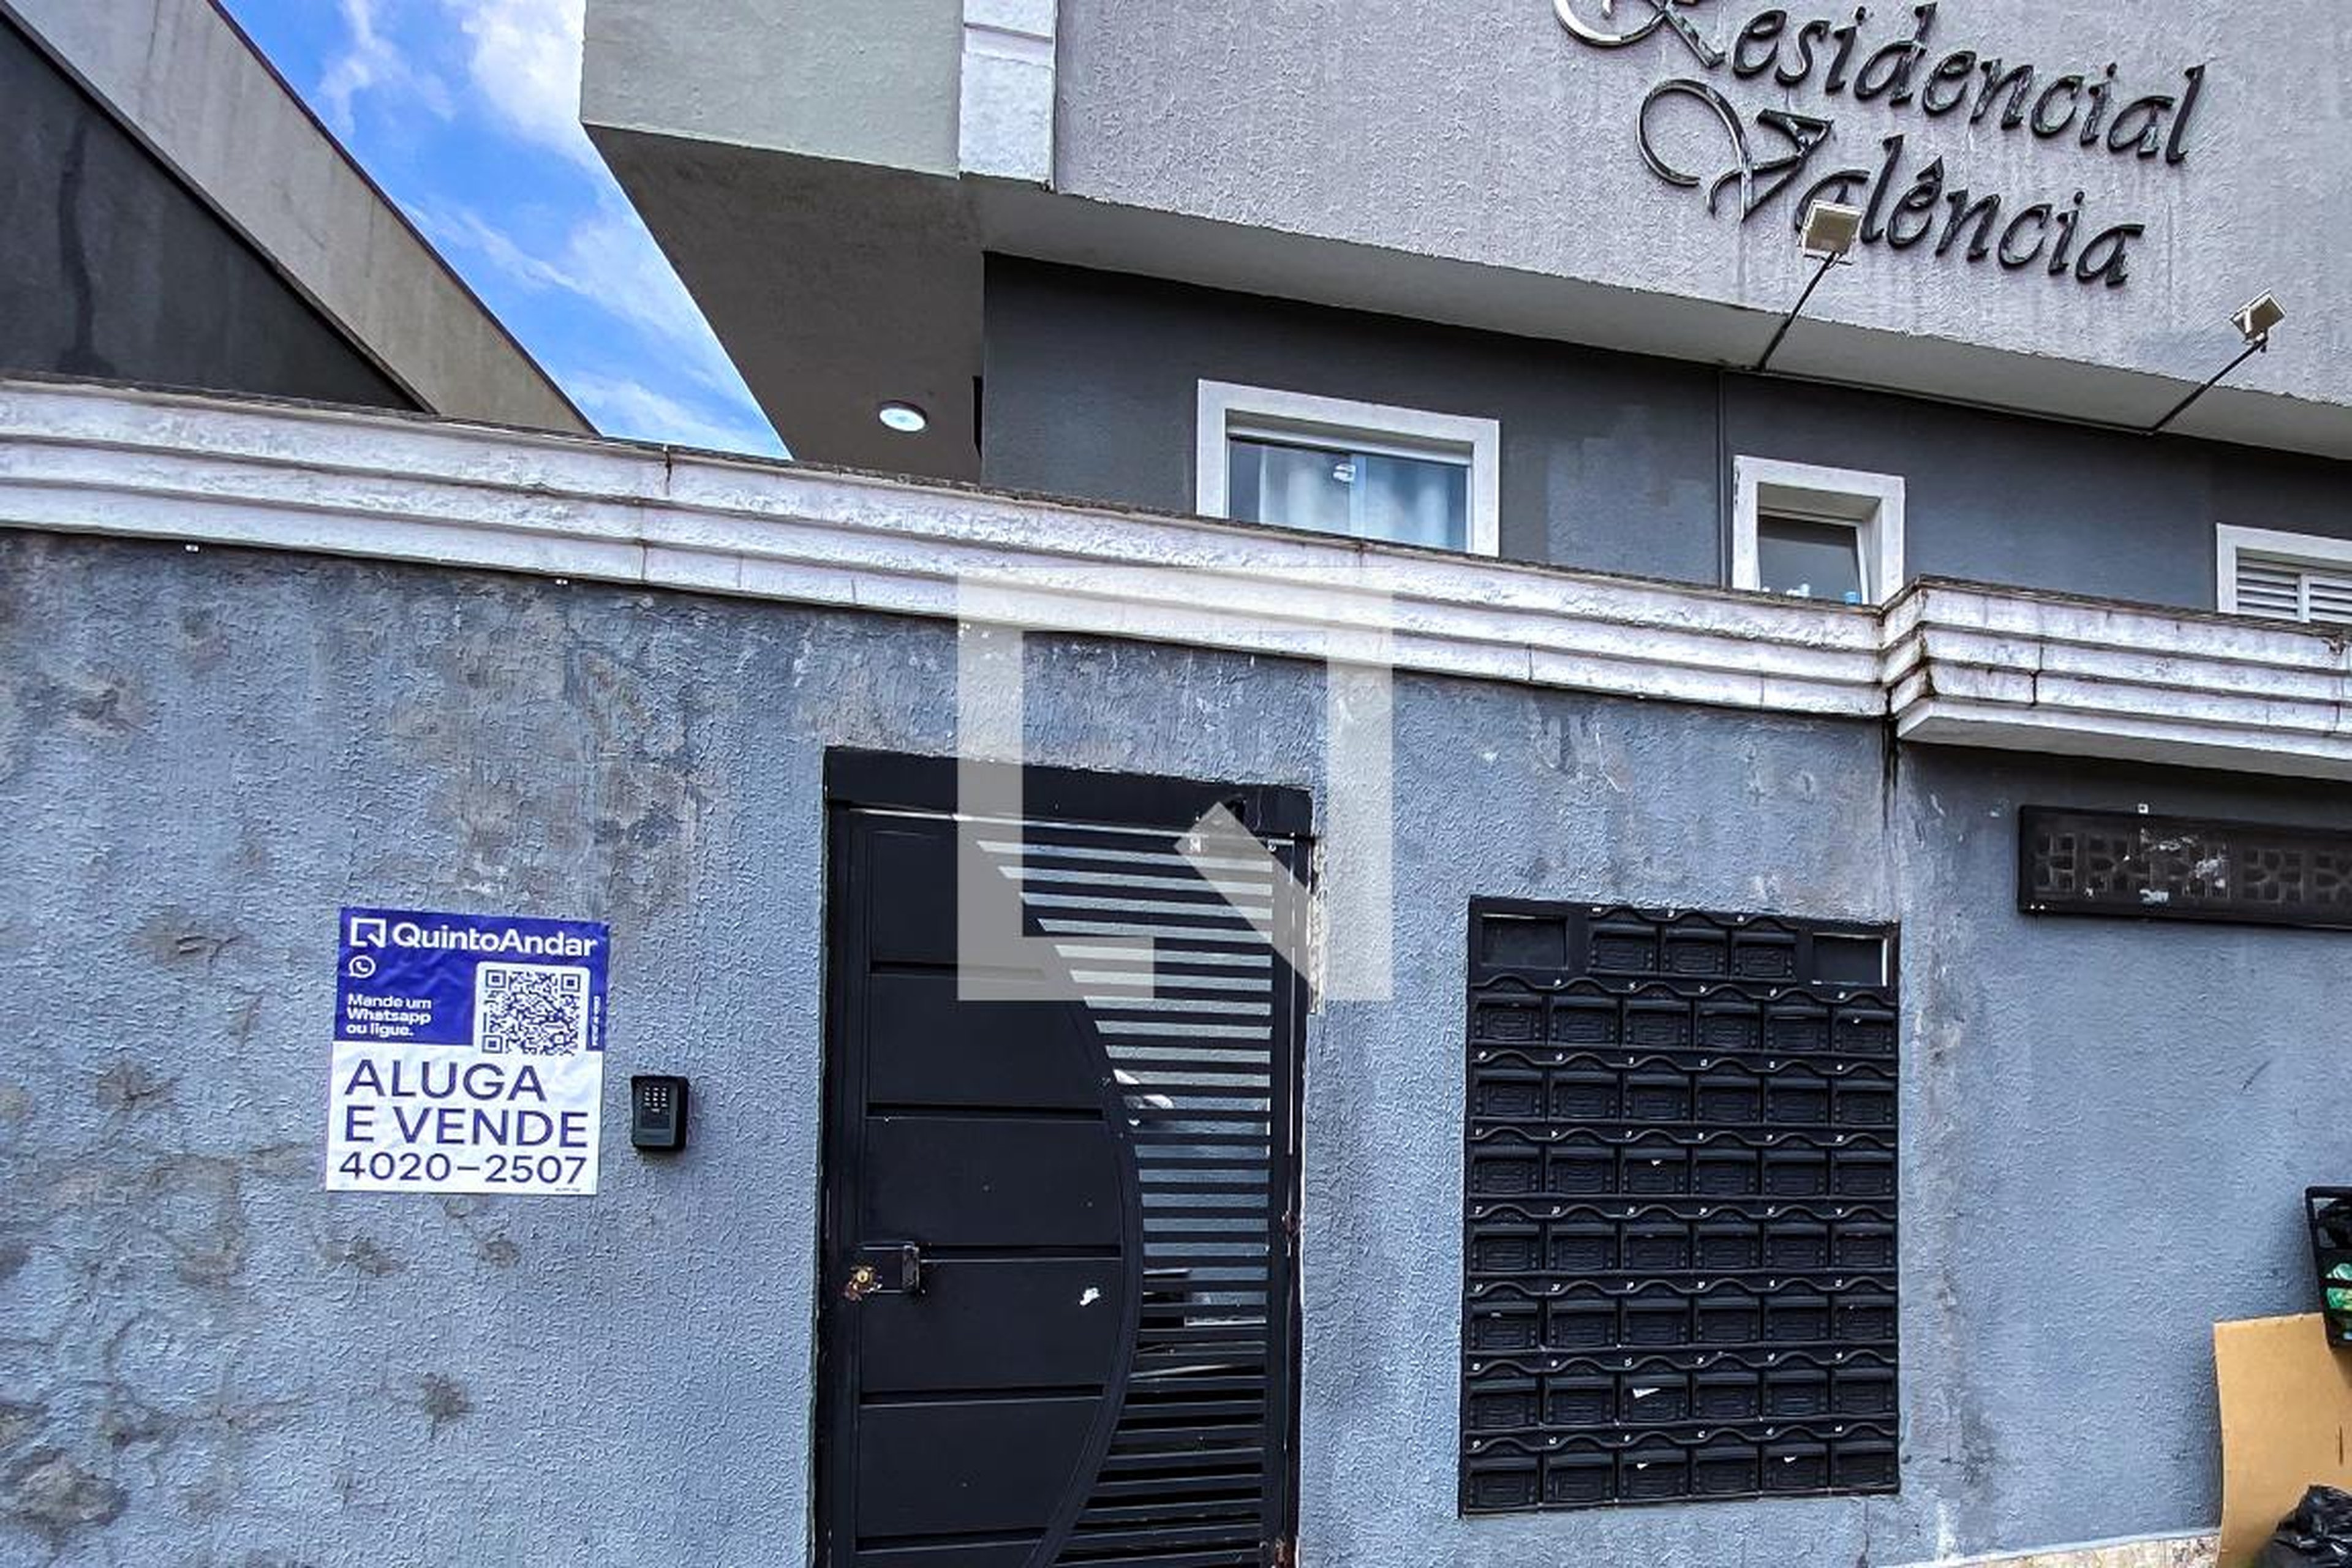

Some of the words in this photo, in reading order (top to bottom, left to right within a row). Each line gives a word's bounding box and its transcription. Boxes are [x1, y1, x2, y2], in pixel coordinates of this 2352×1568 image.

[393, 922, 598, 957] QuintoAndar
[347, 993, 404, 1008] Mande
[406, 999, 432, 1009] um
[347, 1008, 432, 1025] Whatsapp
[346, 1024, 367, 1035] ou
[370, 1023, 414, 1038] ligue.
[344, 1060, 548, 1101] ALUGA
[345, 1105, 375, 1143] E
[393, 1106, 589, 1148] VENDE
[340, 1152, 587, 1185] 4020-2507
